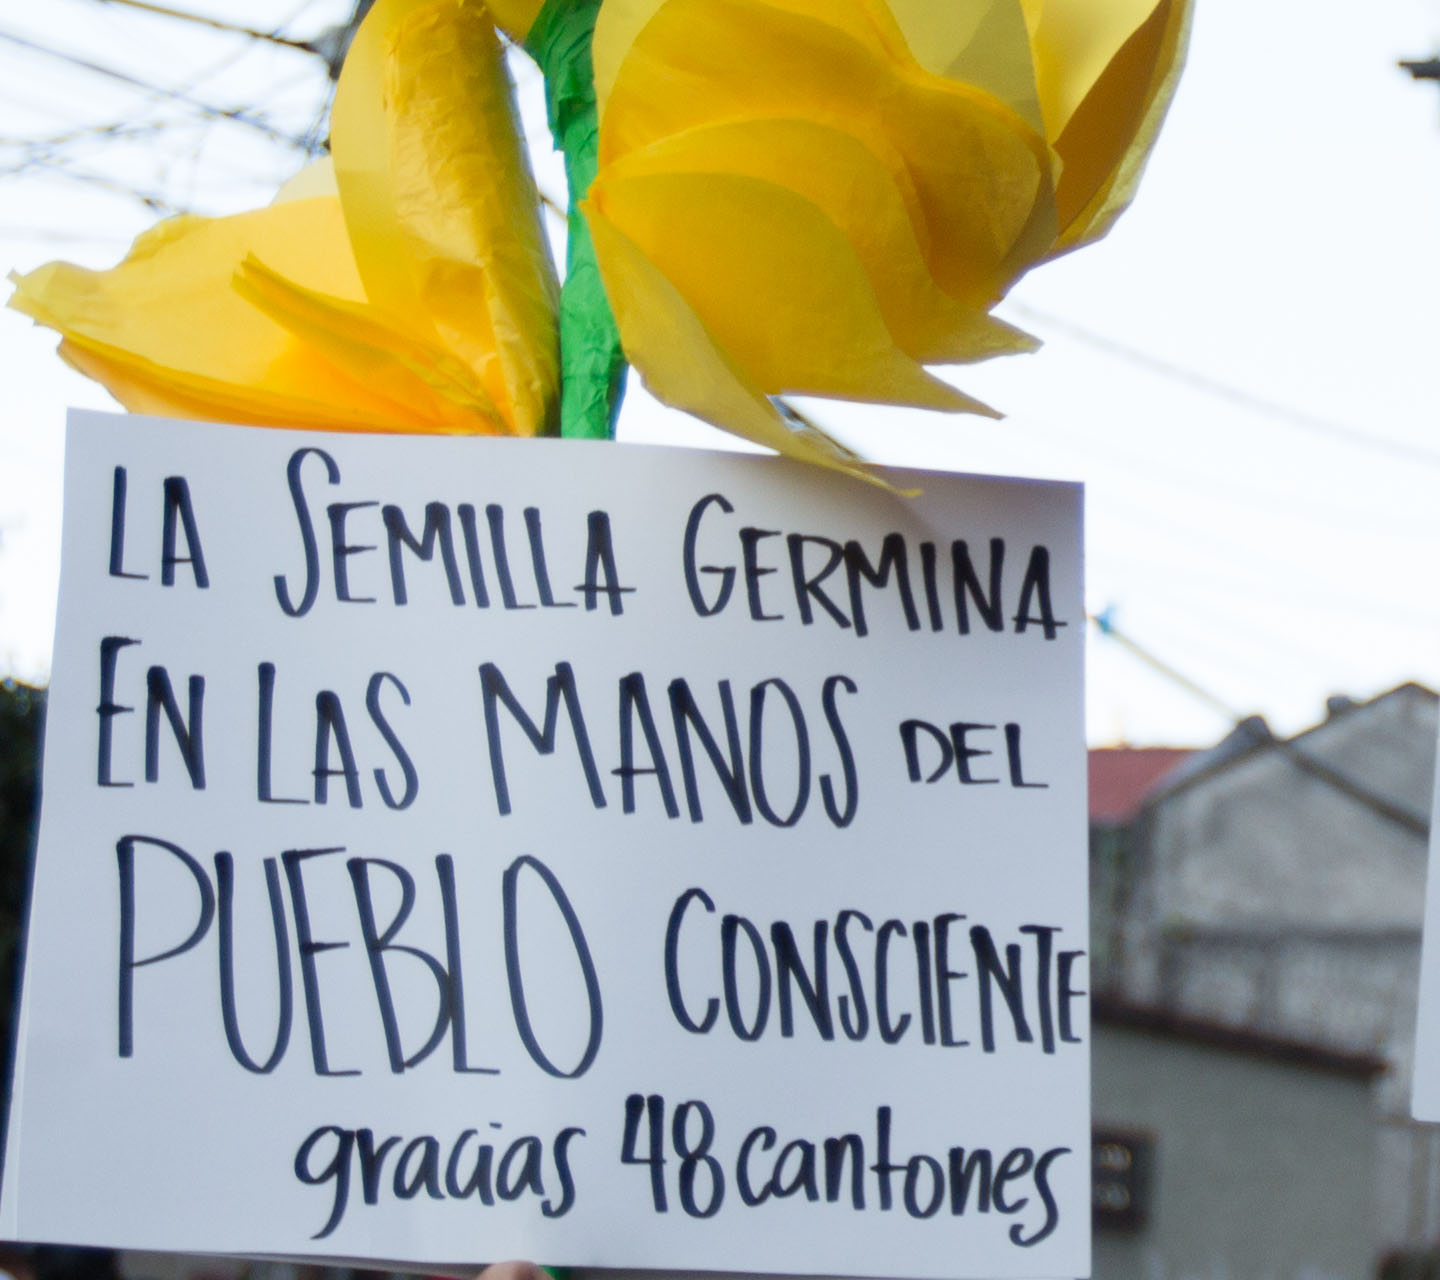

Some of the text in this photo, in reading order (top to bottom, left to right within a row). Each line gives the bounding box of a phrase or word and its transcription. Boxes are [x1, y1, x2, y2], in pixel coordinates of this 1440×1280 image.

[107, 445, 1068, 641] LA SEMILLA GERMINA
[94, 634, 1050, 830] EN LAS MANOS DEL
[114, 833, 1088, 1081] PUEBLO CONSCIENTE
[292, 1092, 1073, 1249] gracias 48 cantones
